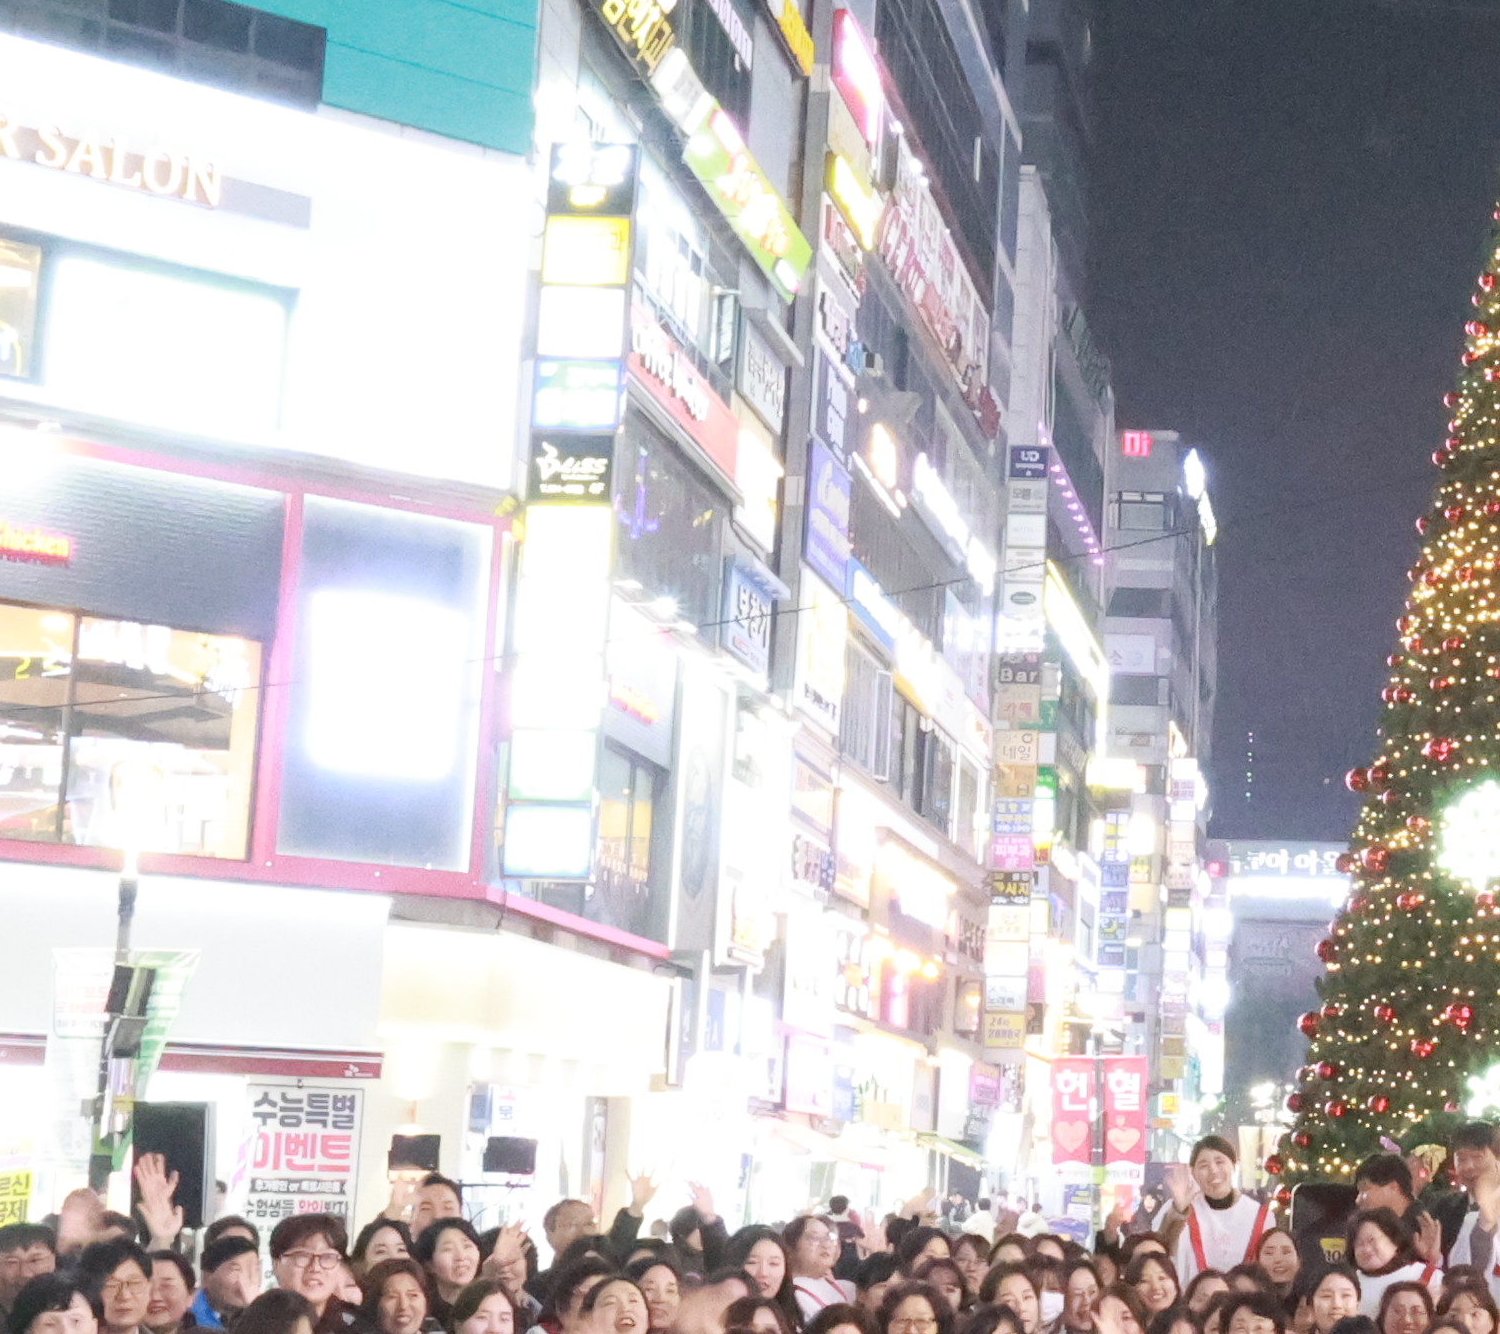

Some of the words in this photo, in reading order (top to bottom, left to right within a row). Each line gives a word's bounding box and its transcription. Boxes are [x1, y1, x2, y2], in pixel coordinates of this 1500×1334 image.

[35, 124, 223, 209] SALON
[252, 1091, 356, 1130] 수능특별
[1054, 1068, 1088, 1111] 헌
[1107, 1069, 1141, 1111] 혈
[252, 1132, 352, 1173] 이벤트
